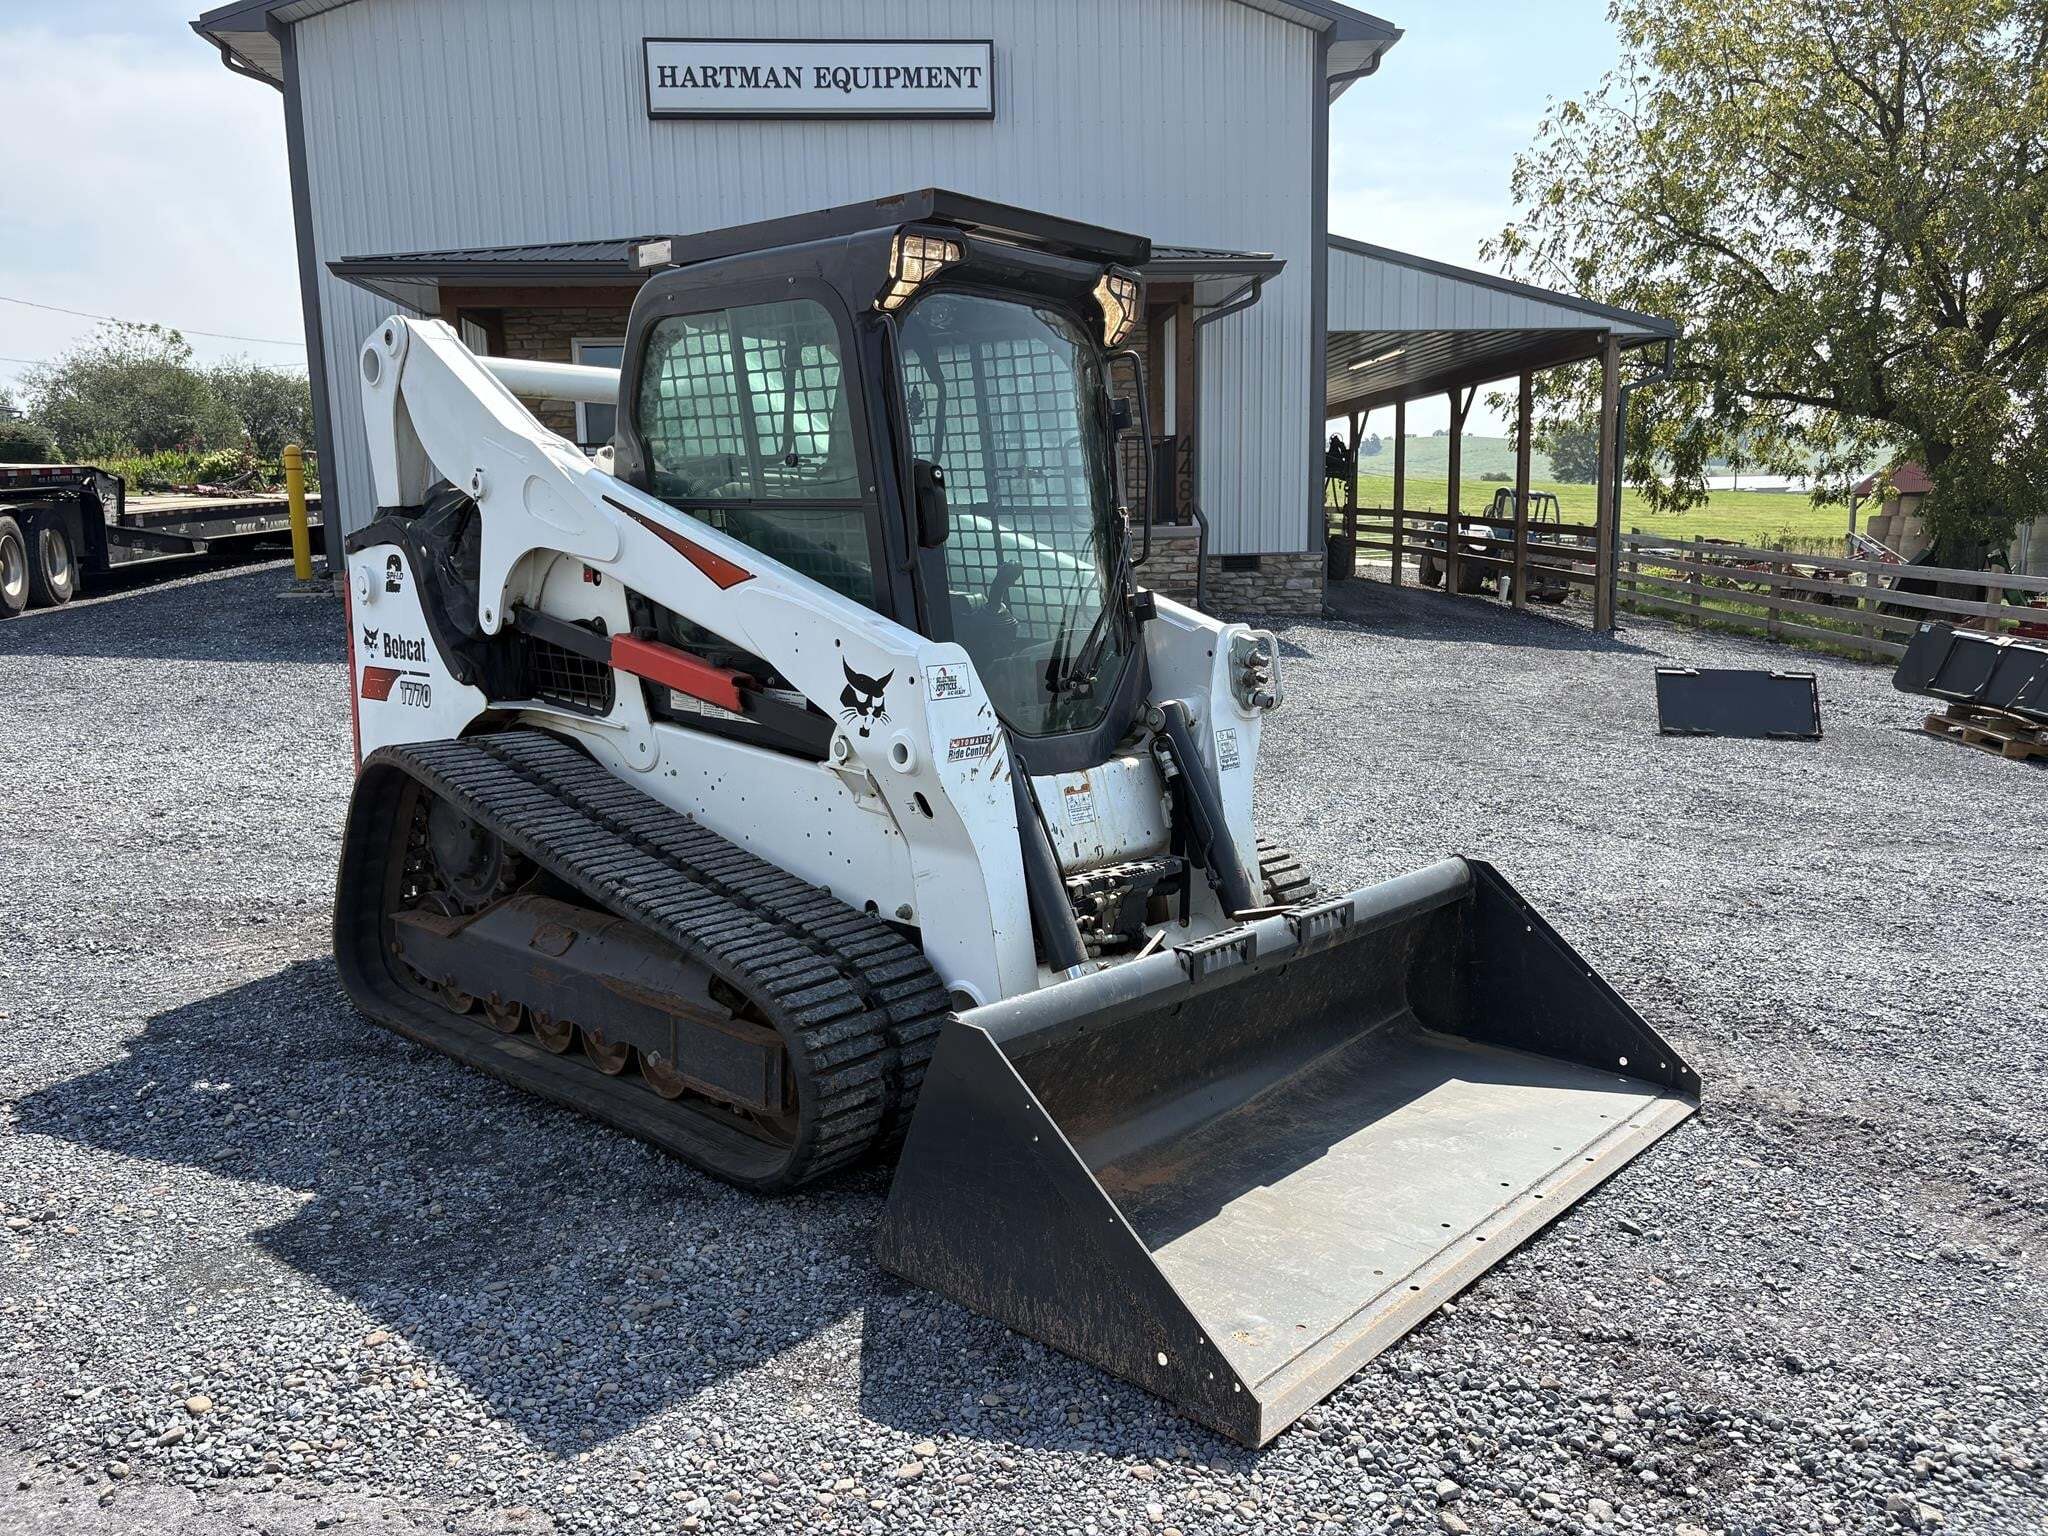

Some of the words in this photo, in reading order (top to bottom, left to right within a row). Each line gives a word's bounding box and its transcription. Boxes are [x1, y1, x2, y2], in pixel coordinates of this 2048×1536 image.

[657, 65, 803, 89] HARTMAN
[813, 66, 982, 94] EQUIPMENT
[383, 632, 427, 663] Bobcat
[400, 680, 432, 709] T770
[948, 748, 965, 760] Ride
